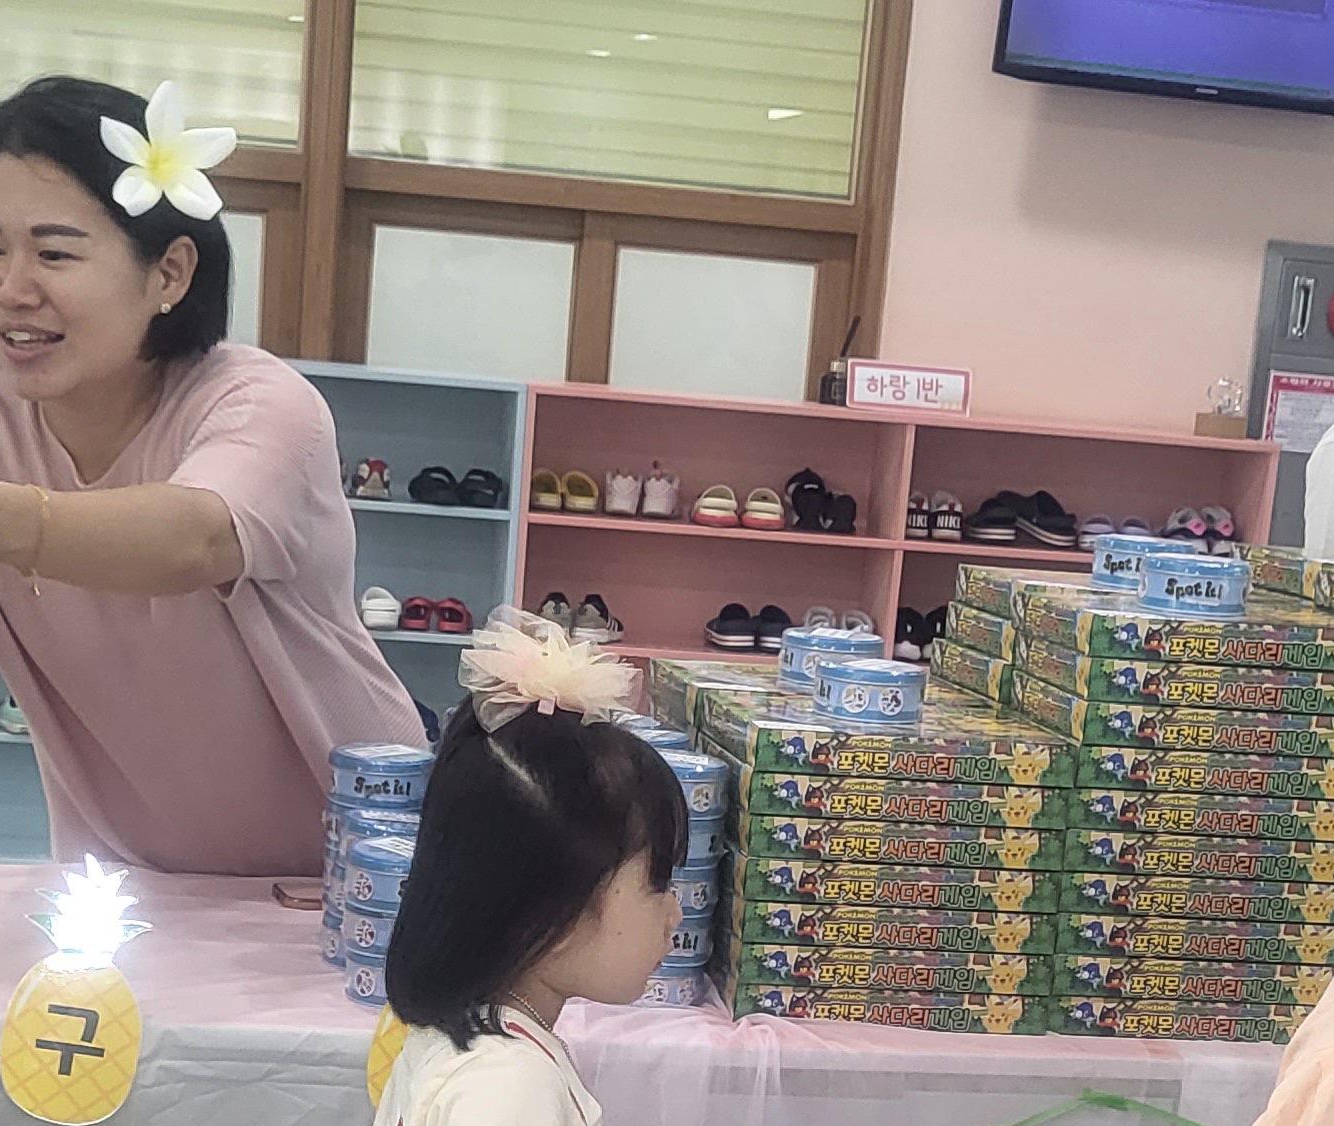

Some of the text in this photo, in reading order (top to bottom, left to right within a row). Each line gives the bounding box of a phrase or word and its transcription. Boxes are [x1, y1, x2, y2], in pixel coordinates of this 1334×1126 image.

[866, 375, 912, 401] 하랑
[1165, 577, 1203, 600] Spot
[1169, 637, 1324, 667] 포켓몬 사다리게임
[1167, 681, 1323, 711] 포켓몬 사다리게임
[1162, 724, 1318, 754] 포켓몬 사다리게임
[837, 751, 997, 781] 포켓몬 사다리게임
[353, 776, 390, 799] Spot
[1155, 766, 1309, 796] 포켓몬 사다리게임
[830, 794, 990, 824] 포켓몬 사다리게임
[1144, 808, 1299, 837] 포켓몬 사다리게임
[829, 837, 987, 866] 포켓몬 사다리게임
[1143, 851, 1297, 879] 포켓몬 사다리게임
[824, 880, 982, 908] 포켓몬 사다리게임
[1136, 892, 1290, 919] 포켓몬 사다리게임
[822, 922, 979, 950] 포켓몬 사다리게임
[1133, 934, 1286, 961] 포켓몬 사다리게임
[818, 964, 975, 992] 포켓몬 사다리게임
[1129, 975, 1283, 1002] 포켓몬 사다리게임
[869, 1005, 970, 1031] 사다리게임
[1123, 1015, 1276, 1042] 포켓몬 사다리게임
[35, 1003, 105, 1077] 구
